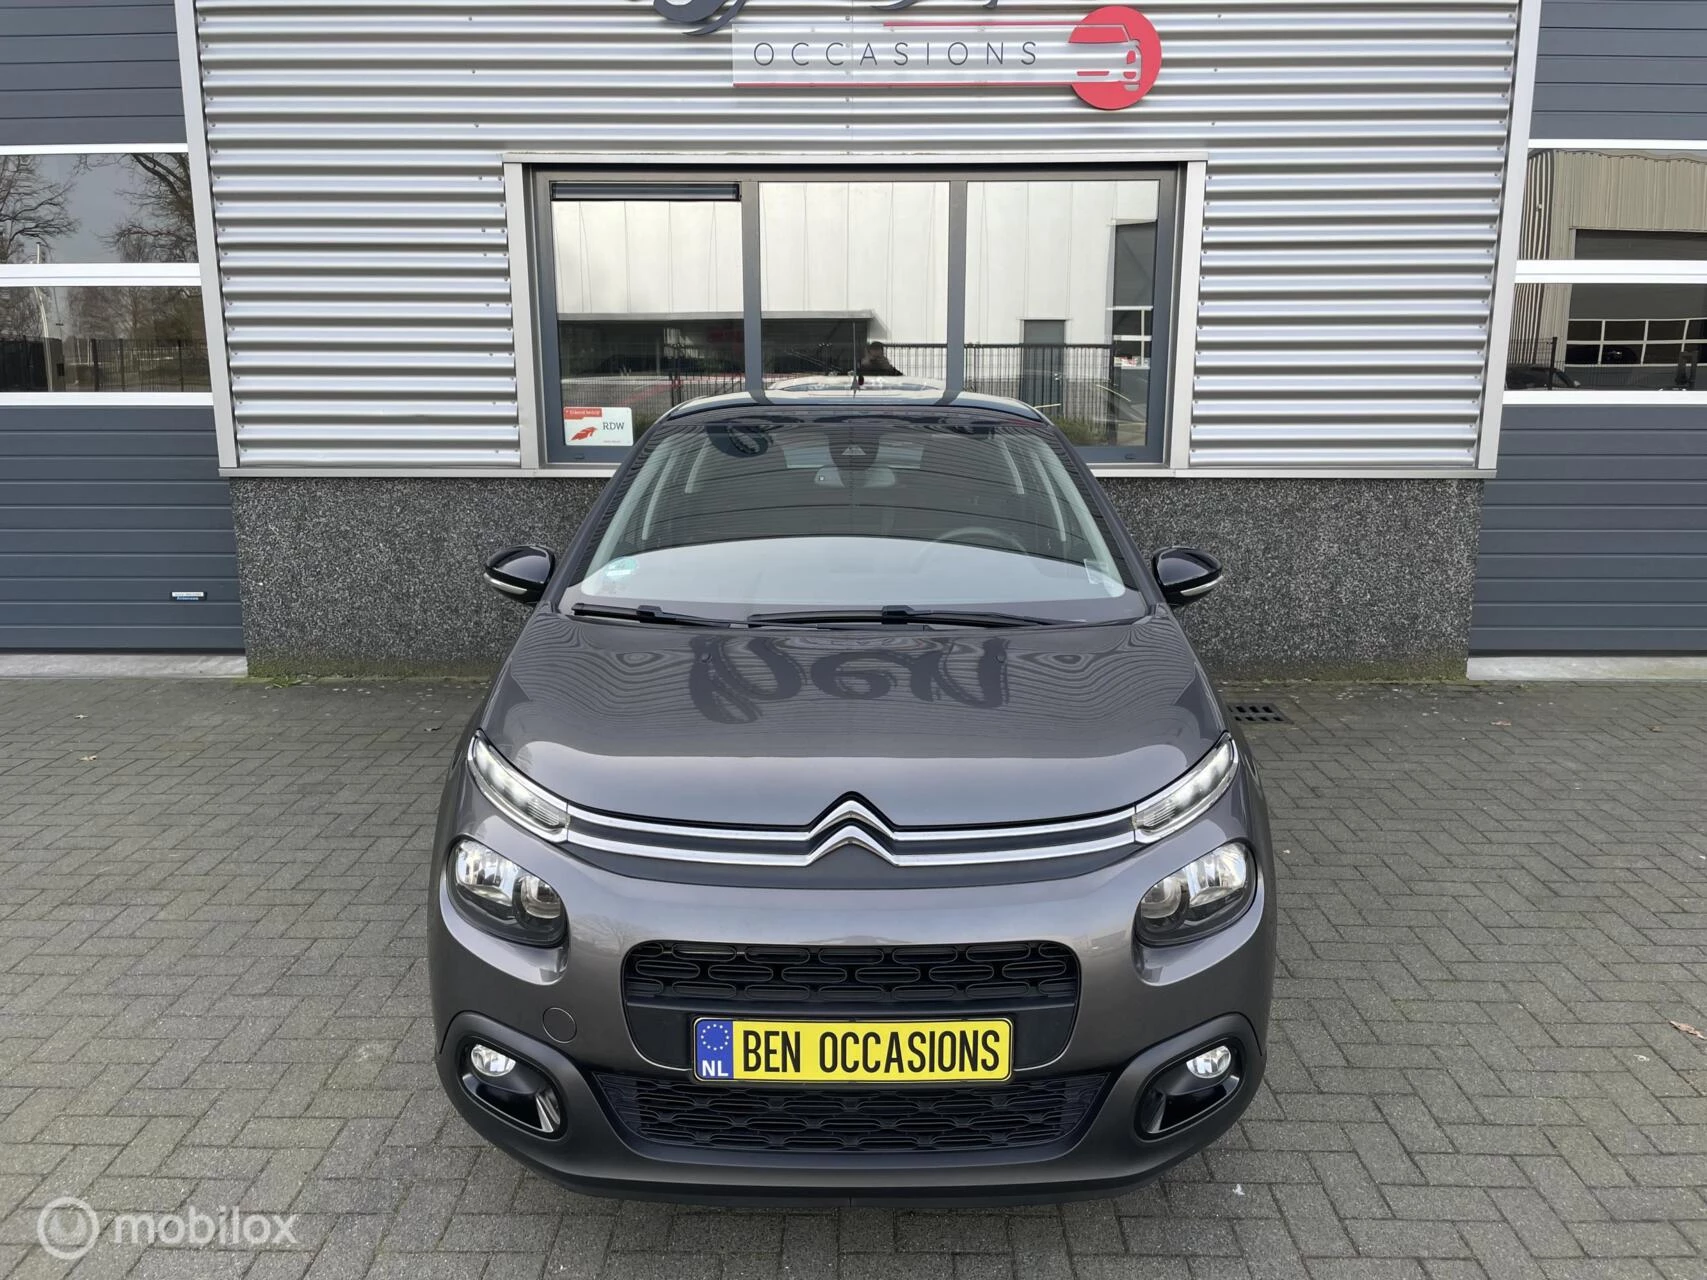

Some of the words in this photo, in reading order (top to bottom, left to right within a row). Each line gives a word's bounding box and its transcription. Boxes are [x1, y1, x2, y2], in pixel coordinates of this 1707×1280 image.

[752, 41, 1037, 67] OCCASIONS
[602, 422, 625, 431] RDW
[742, 1030, 801, 1073] BEN
[819, 1030, 1000, 1073] OCCASIONS
[702, 1060, 729, 1077] NL
